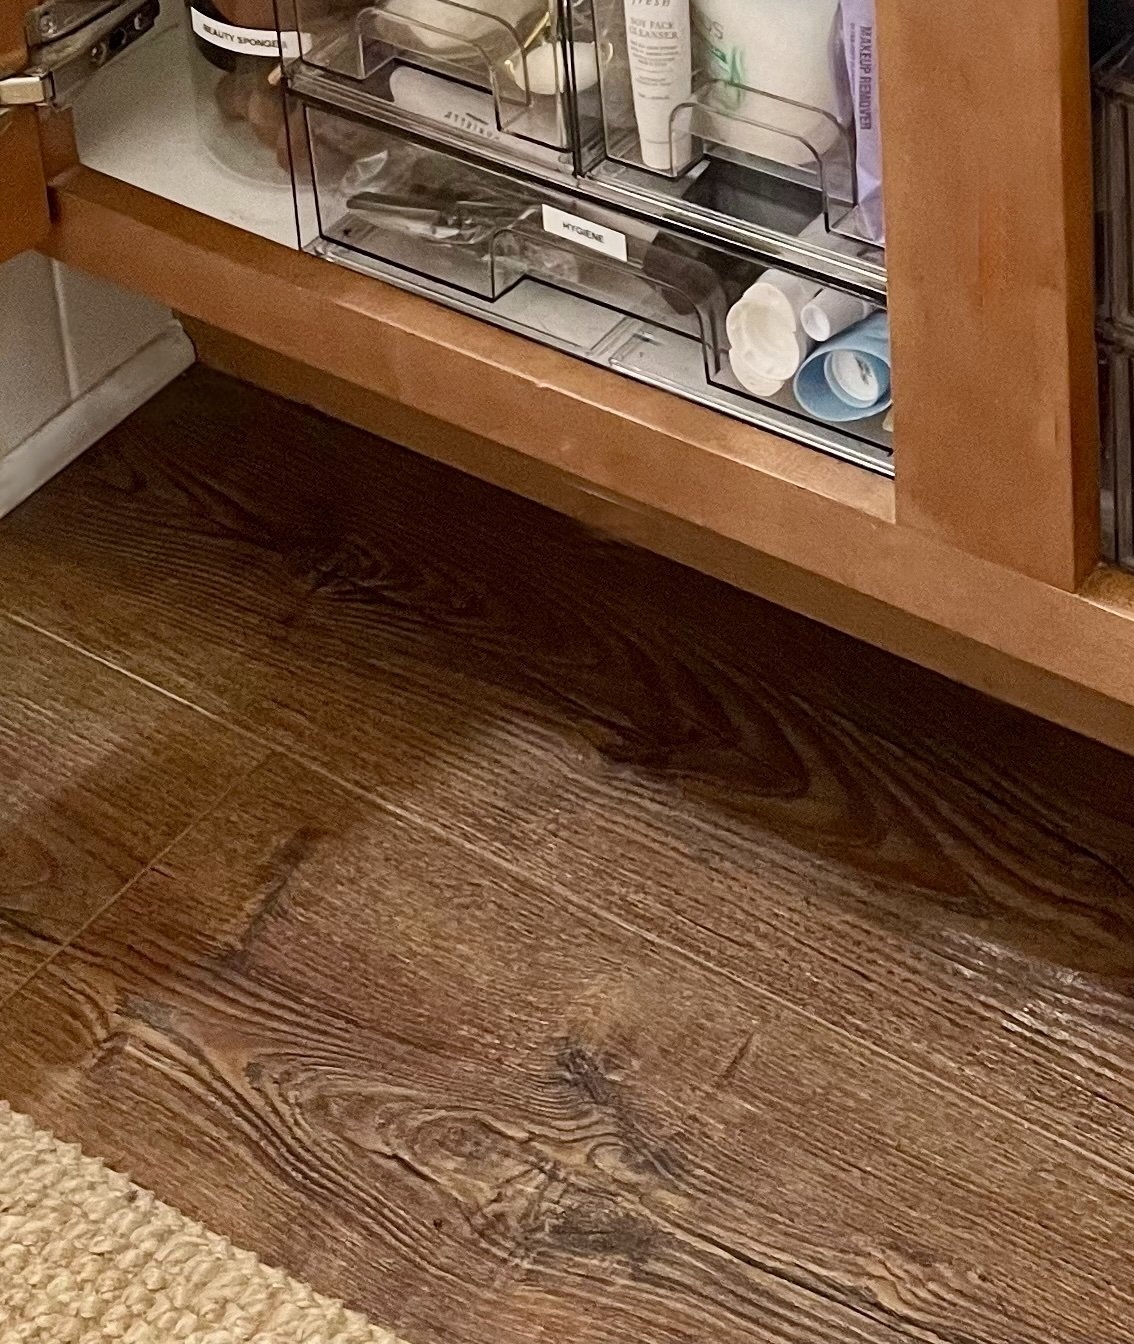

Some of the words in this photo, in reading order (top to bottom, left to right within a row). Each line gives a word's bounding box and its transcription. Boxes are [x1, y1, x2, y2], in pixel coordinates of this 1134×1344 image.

[203, 23, 234, 42] BEAUTY
[860, 26, 872, 74] MAKEUP
[859, 77, 872, 130] REMOVER
[563, 222, 605, 243] HYGIENE
